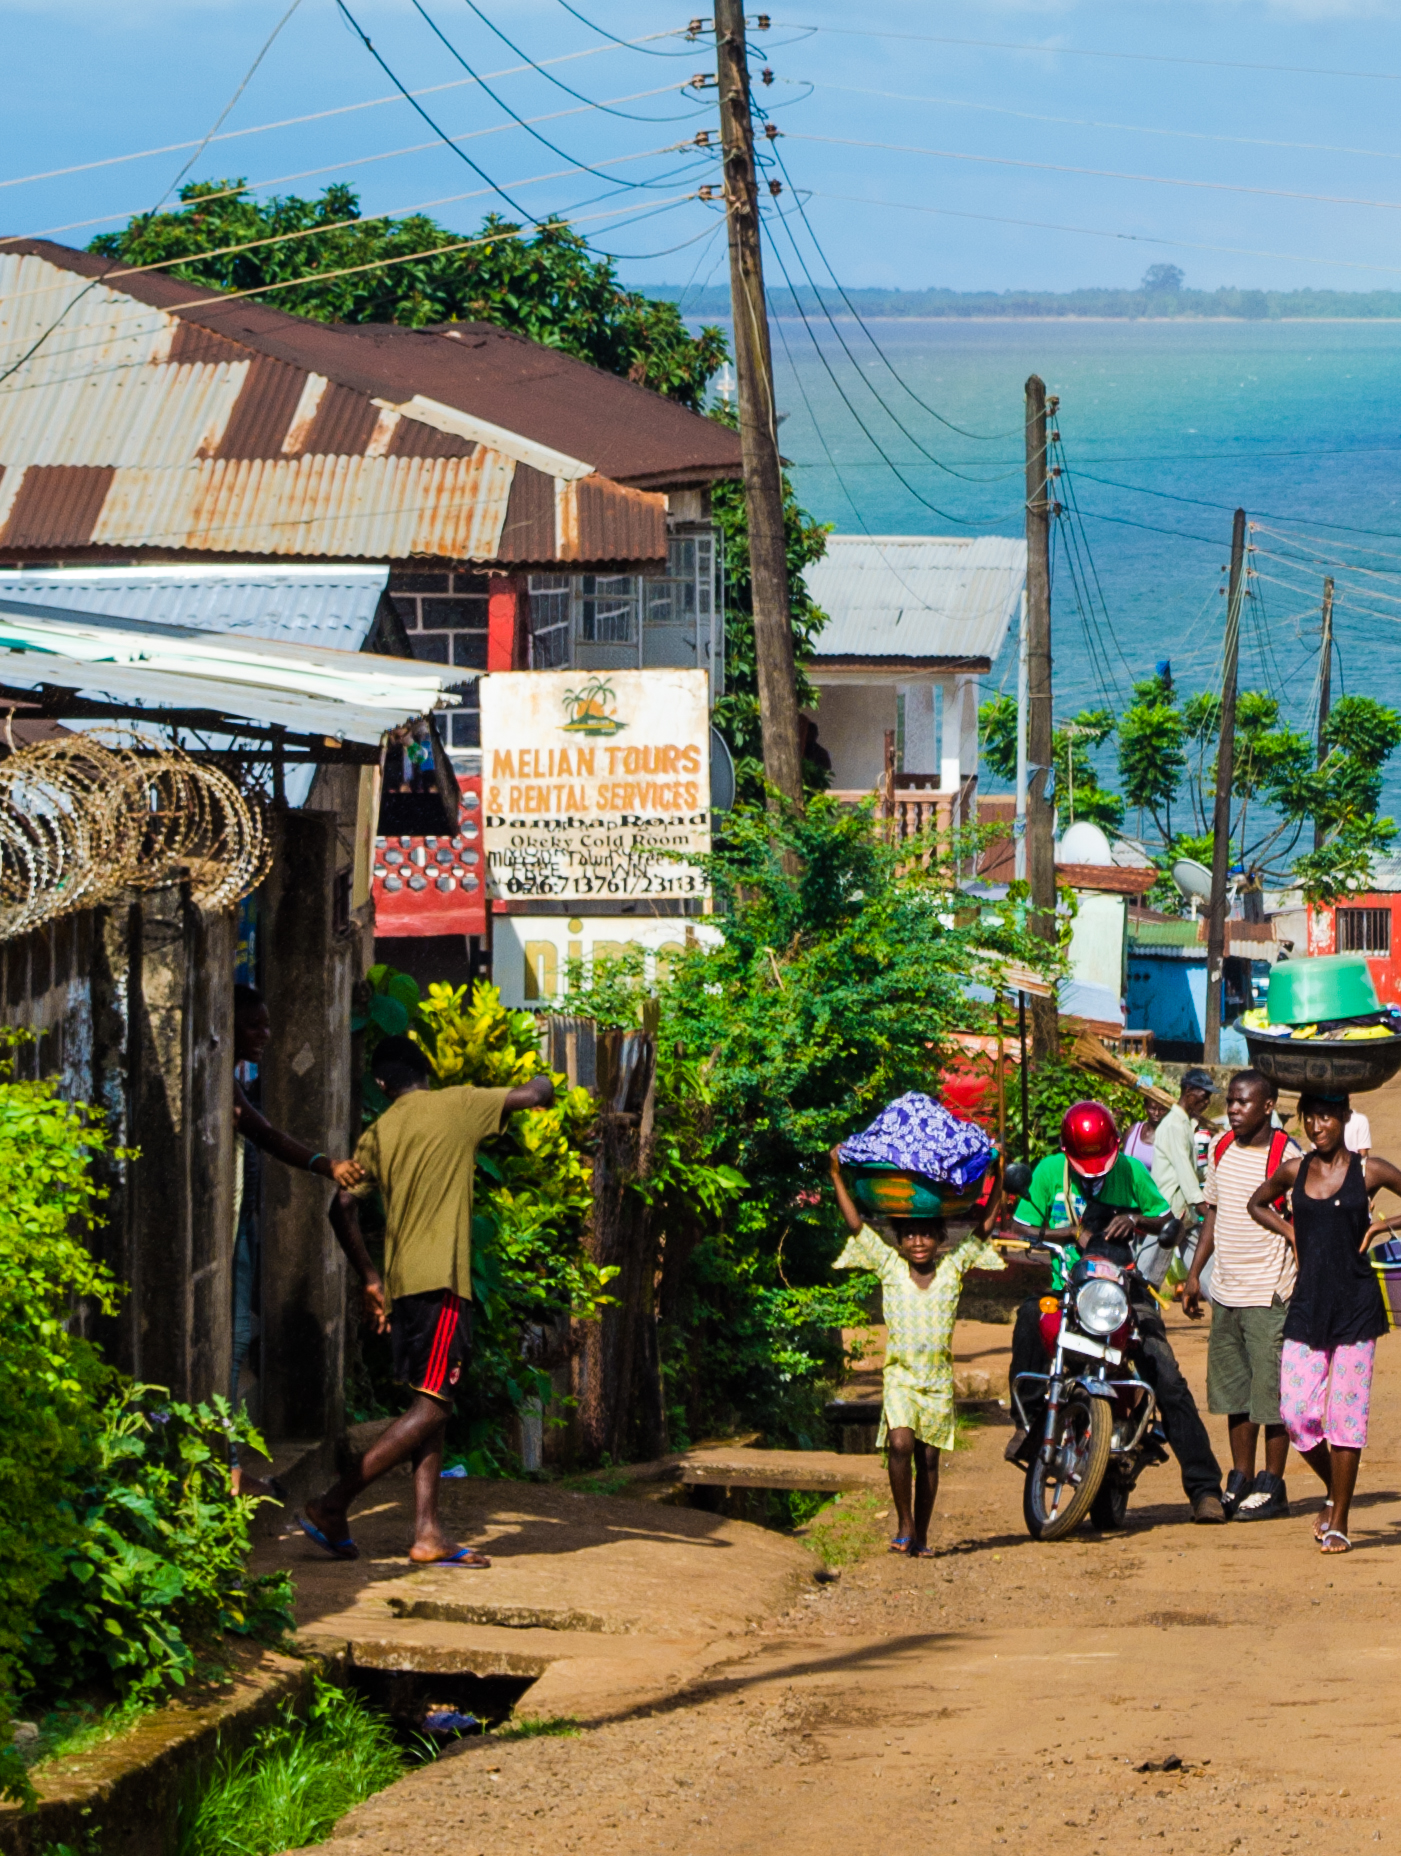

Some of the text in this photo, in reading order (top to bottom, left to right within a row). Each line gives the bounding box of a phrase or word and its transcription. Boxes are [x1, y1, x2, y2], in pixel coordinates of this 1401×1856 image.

[492, 743, 701, 779] MELIAN TOURS
[487, 781, 699, 814] & RENTAL SERVICES
[486, 815, 605, 828] Damba
[621, 813, 707, 827] Road
[580, 834, 623, 848] Cold
[631, 833, 689, 847] Room
